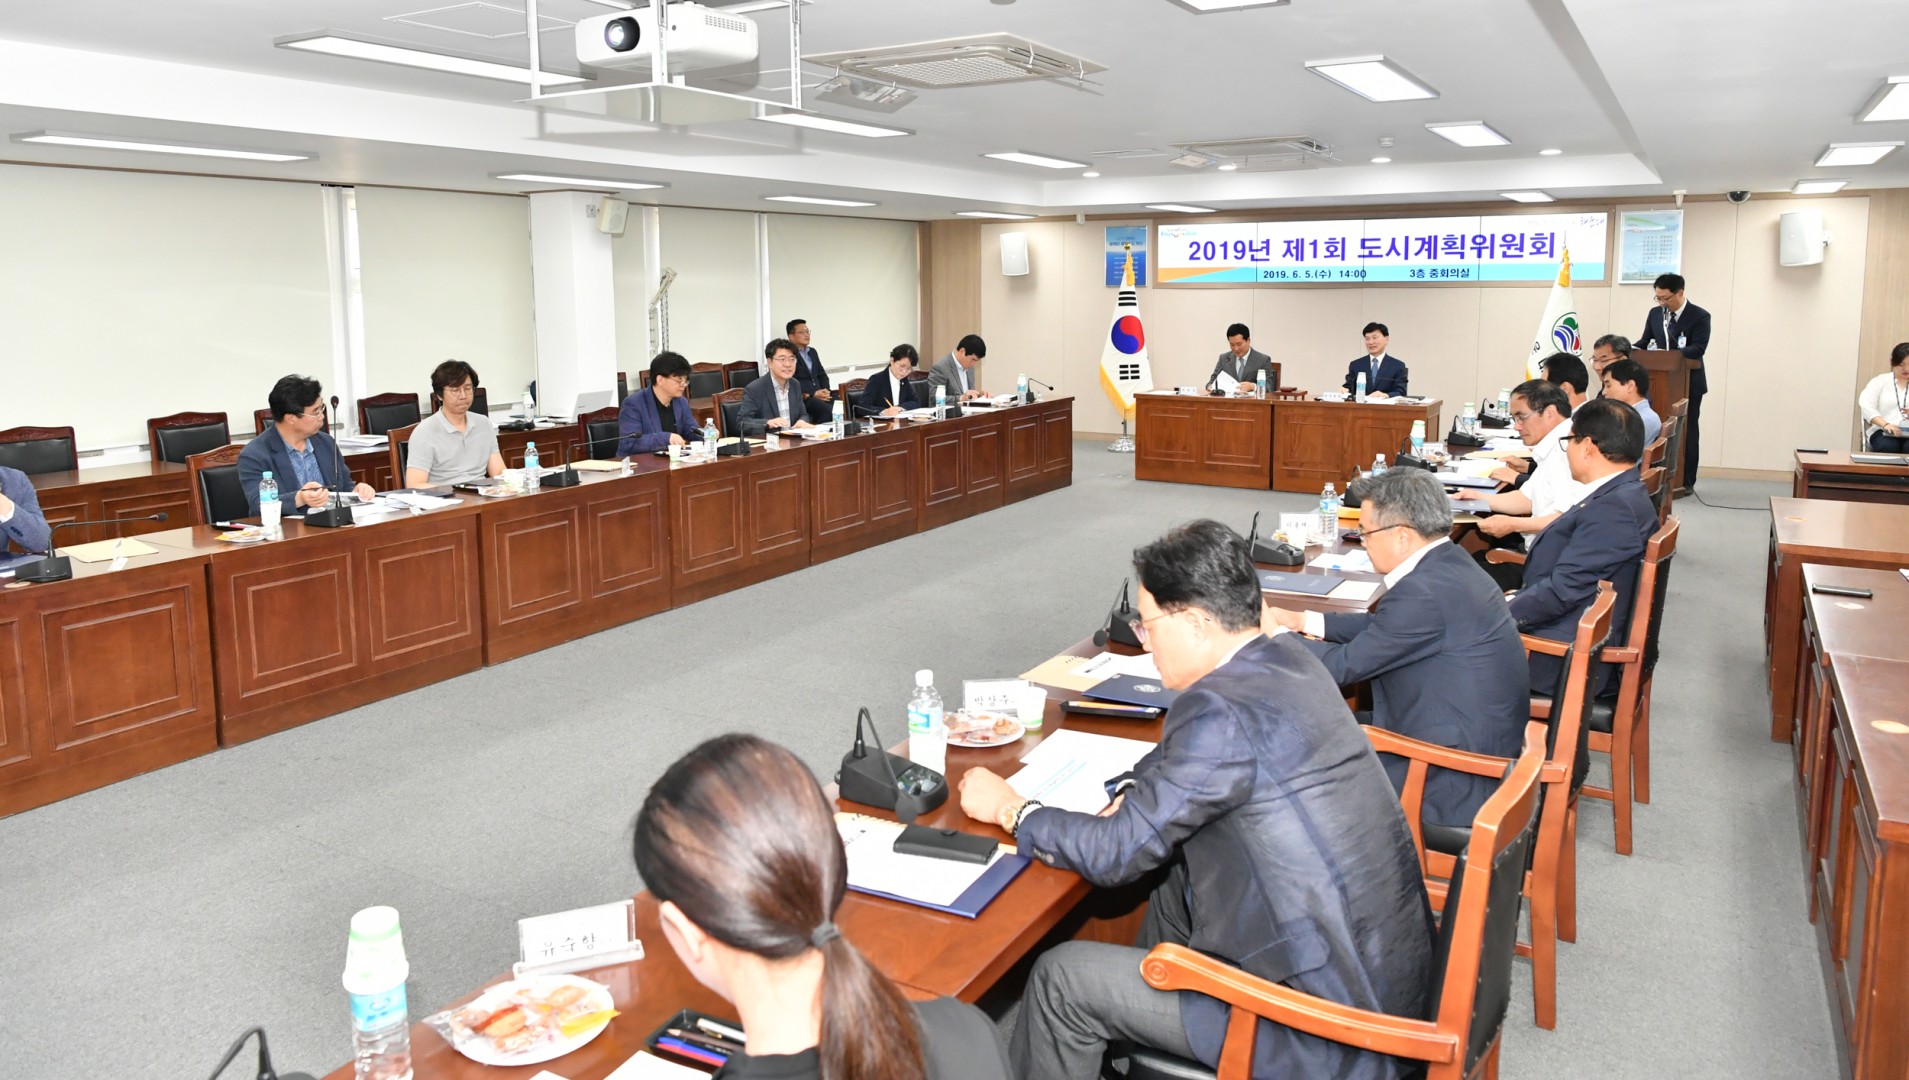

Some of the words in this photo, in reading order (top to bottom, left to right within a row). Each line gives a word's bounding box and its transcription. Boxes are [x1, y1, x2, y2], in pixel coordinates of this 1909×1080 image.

[1188, 238, 1271, 262] 2019년
[1282, 236, 1346, 262] 제1회
[1357, 232, 1555, 260] 도시계획위원회
[1263, 270, 1289, 279] 2019.
[1292, 270, 1301, 279] 6.
[1304, 269, 1332, 279] 5.(수)
[1339, 269, 1367, 278] 14:00
[1409, 268, 1426, 278] 3층
[1429, 268, 1470, 279] 중회의실
